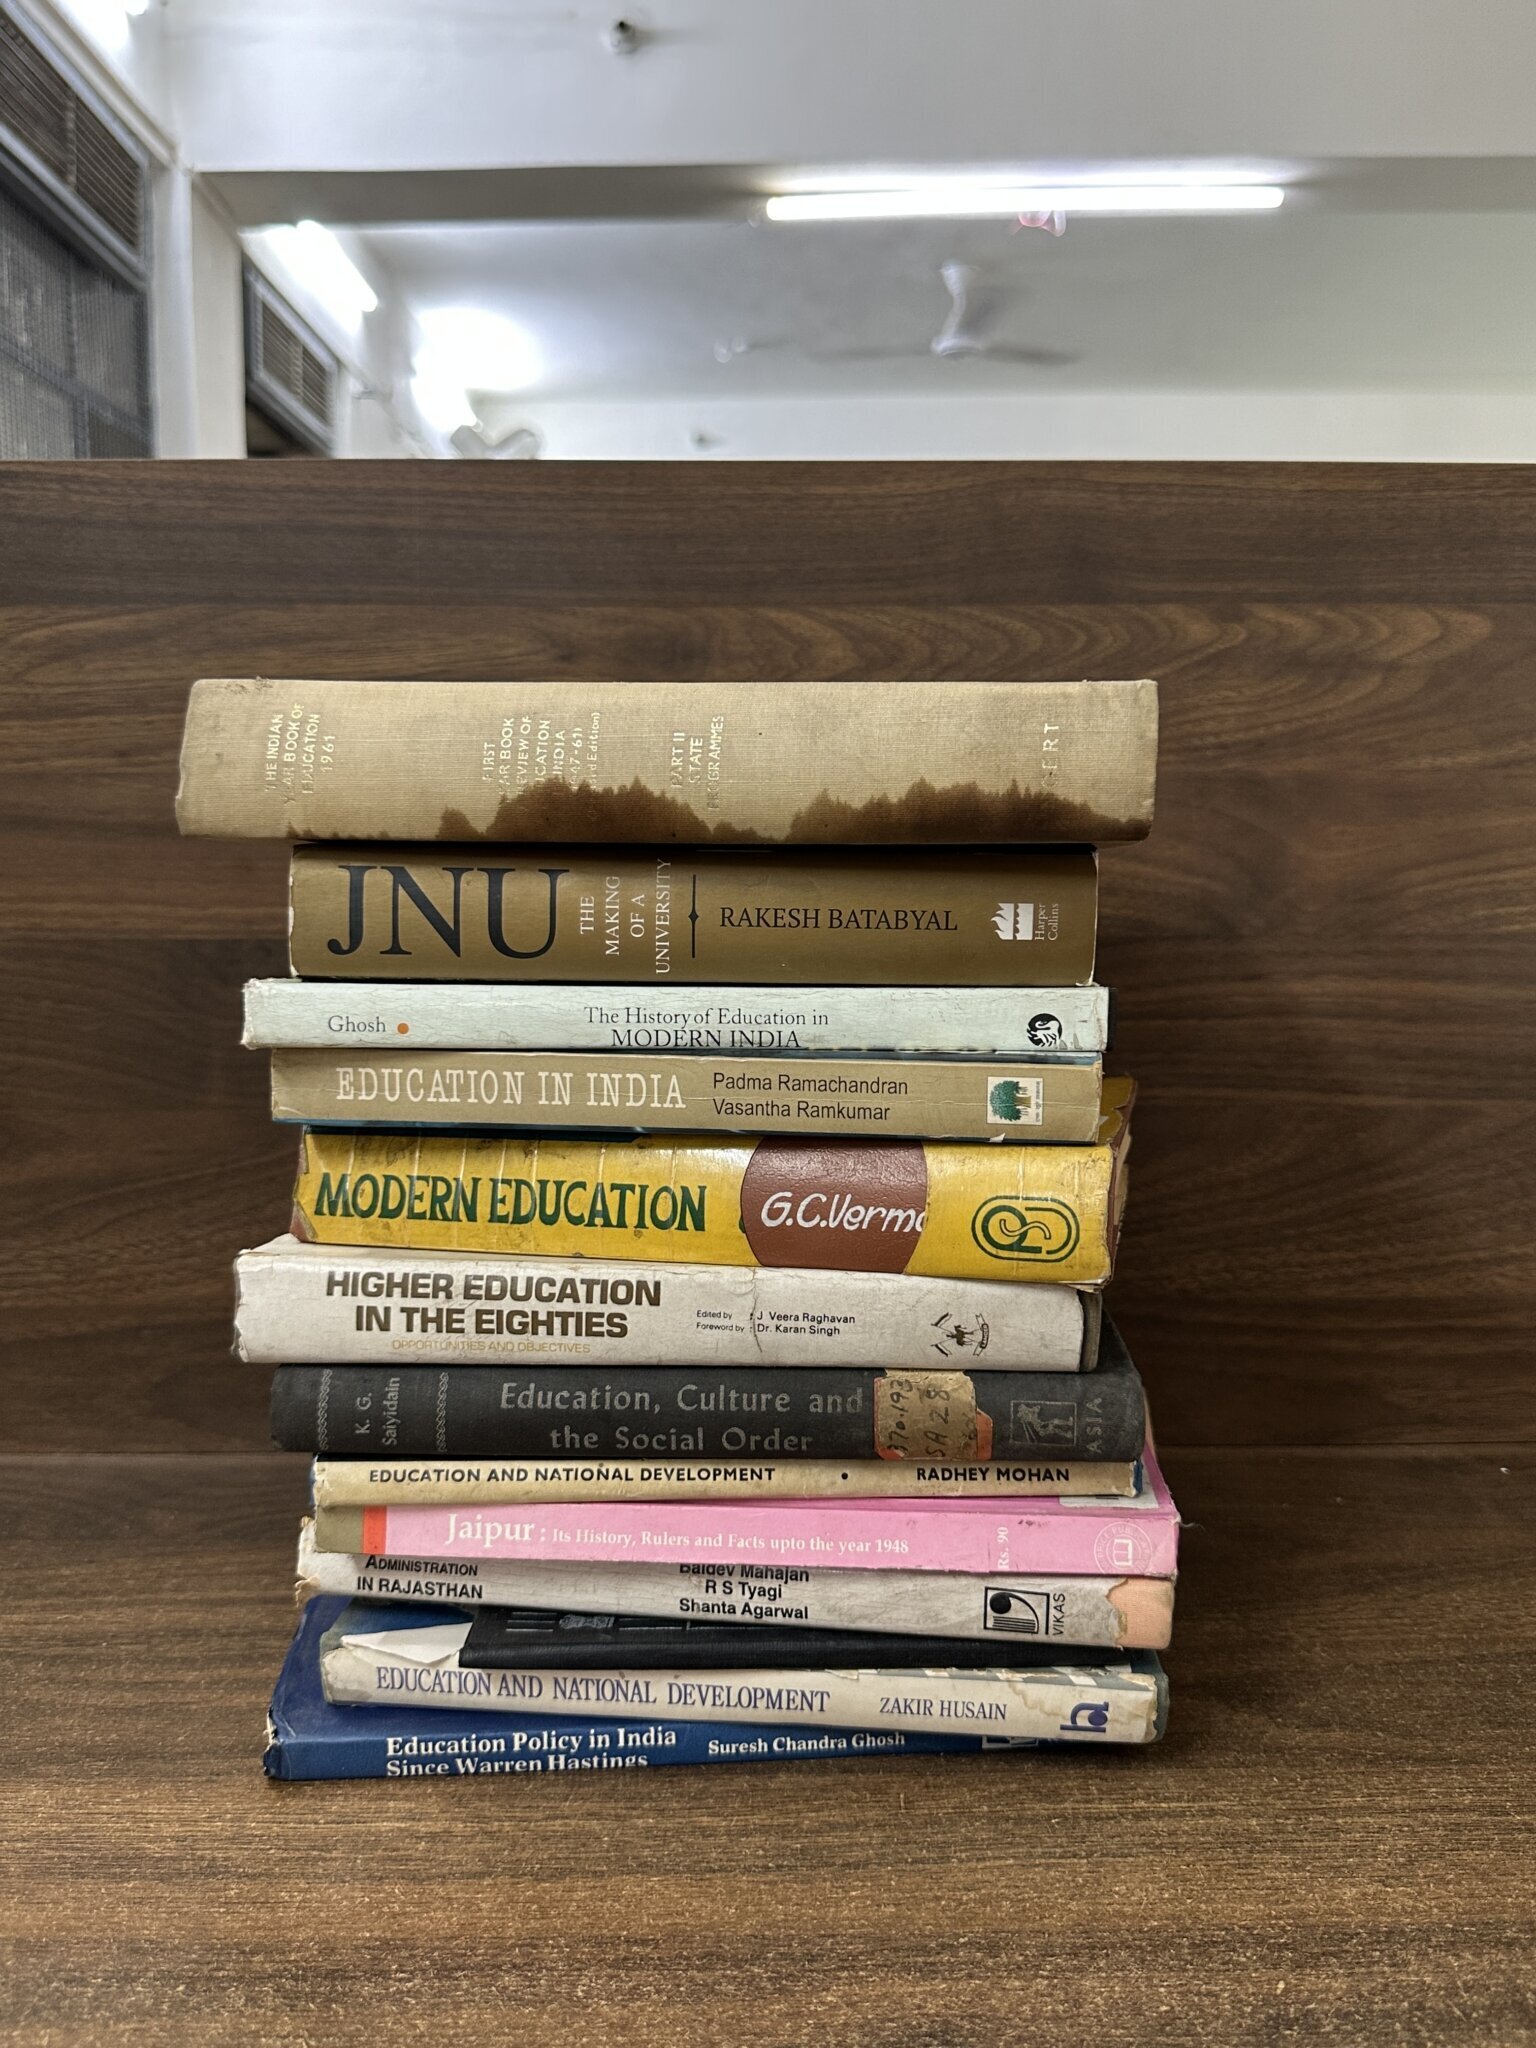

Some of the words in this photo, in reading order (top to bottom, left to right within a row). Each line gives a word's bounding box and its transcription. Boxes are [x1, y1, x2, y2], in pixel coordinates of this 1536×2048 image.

[265, 713, 284, 760] INDIAN
[500, 718, 515, 761] BOOK
[520, 714, 532, 735] OF
[587, 711, 600, 761] Edition)
[283, 721, 301, 762] BOOK
[320, 735, 336, 773] 1961
[552, 730, 566, 776] INDIA
[670, 746, 684, 789] PART
[688, 737, 703, 785] STATE
[327, 865, 570, 959] JNU
[580, 896, 595, 935] THE
[605, 876, 620, 956] MAKING
[631, 894, 645, 908] A
[655, 858, 671, 975] UNIVERSITY
[630, 912, 645, 938] OF
[719, 906, 820, 930] RAKESH
[828, 908, 959, 932] BATABYAL
[1034, 903, 1049, 941] Harper
[1047, 903, 1059, 941] Collins
[327, 1014, 387, 1034] Ghosh
[583, 1006, 620, 1025] The
[625, 1007, 689, 1029] History
[693, 1008, 715, 1025] of
[718, 1008, 807, 1026] Education
[812, 1008, 829, 1026] in
[611, 1028, 722, 1048] MODERN
[730, 1030, 802, 1048] INDIA
[336, 1066, 525, 1105] EDUCATION
[537, 1071, 574, 1106] IN
[586, 1072, 687, 1109] INDIA
[712, 1072, 773, 1092] Padma
[778, 1073, 909, 1096] Ramachandran
[712, 1097, 793, 1118] Vasantha
[796, 1100, 891, 1122] Ramkumar
[314, 1172, 483, 1223] MODERN
[488, 1178, 708, 1232] EDUCATION
[325, 1270, 454, 1300] HIGHER
[462, 1274, 662, 1307] EDUCATION
[355, 1304, 392, 1332] IN
[400, 1306, 466, 1334] THE
[475, 1308, 629, 1339] EIGHTIES
[695, 1322, 734, 1332] Foreword
[735, 1324, 745, 1333] by
[757, 1323, 773, 1333] Dr.
[775, 1324, 807, 1335] Karan
[808, 1325, 841, 1337] Singh
[696, 1309, 722, 1319] Edited
[722, 1311, 733, 1321] by
[768, 1311, 800, 1322] Veera
[802, 1312, 856, 1325] Raghavan
[391, 1339, 487, 1352] OPPORTUNITIES
[489, 1341, 516, 1352] AND
[517, 1341, 592, 1354] OBJECTIVES
[355, 1391, 373, 1411] G.
[381, 1376, 401, 1447] Saiyidain
[500, 1382, 662, 1415] Education,
[676, 1383, 793, 1413] Culture
[808, 1386, 864, 1414] and
[354, 1418, 371, 1436] K.
[550, 1424, 600, 1450] the
[615, 1425, 704, 1451] Social
[720, 1427, 814, 1452] Order
[1085, 1397, 1103, 1455] ASIA
[369, 1468, 481, 1484] EDUCATION
[486, 1468, 529, 1483] AND
[535, 1467, 635, 1482] NATIONAL
[640, 1467, 777, 1482] DEVELOPMENT
[916, 1467, 990, 1482] RADHEY
[996, 1467, 1070, 1483] MOHAN
[445, 1513, 535, 1548] Jaipur
[552, 1528, 572, 1543] Its
[575, 1529, 637, 1549] History,
[641, 1531, 690, 1546] Rulers
[694, 1533, 723, 1548] and
[728, 1534, 766, 1549] Facts
[770, 1536, 806, 1554] upto
[809, 1536, 834, 1551] the
[838, 1540, 872, 1556] year
[875, 1538, 910, 1554] 1948
[996, 1526, 1009, 1543] 90
[365, 1554, 479, 1577] ADMINISTRATION
[740, 1565, 810, 1585] Mahajan
[356, 1576, 374, 1591] IN
[378, 1577, 484, 1600] RAJASTHAN
[705, 1579, 717, 1594] R
[722, 1580, 733, 1596] S
[738, 1581, 783, 1601] Tyagi
[679, 1598, 737, 1615] Shanta
[741, 1601, 809, 1620] Agarwal
[1052, 1592, 1066, 1636] VIKAS
[376, 1666, 493, 1697] EDUCATION
[498, 1673, 544, 1699] AND
[552, 1676, 658, 1705] NATIONAL
[667, 1681, 831, 1713] DEVELOPMENT
[879, 1696, 934, 1717] ZAKIR
[939, 1699, 1008, 1721] HUSAIN
[386, 1733, 506, 1757] Education
[512, 1731, 584, 1753] Policy
[589, 1728, 610, 1748] in
[617, 1725, 677, 1748] India
[708, 1737, 769, 1755] Suresh
[772, 1734, 848, 1752] Chandra
[851, 1731, 906, 1749] Ghosh
[386, 1759, 450, 1777] Since
[455, 1756, 543, 1775] Warren
[547, 1751, 649, 1773] Hastings
